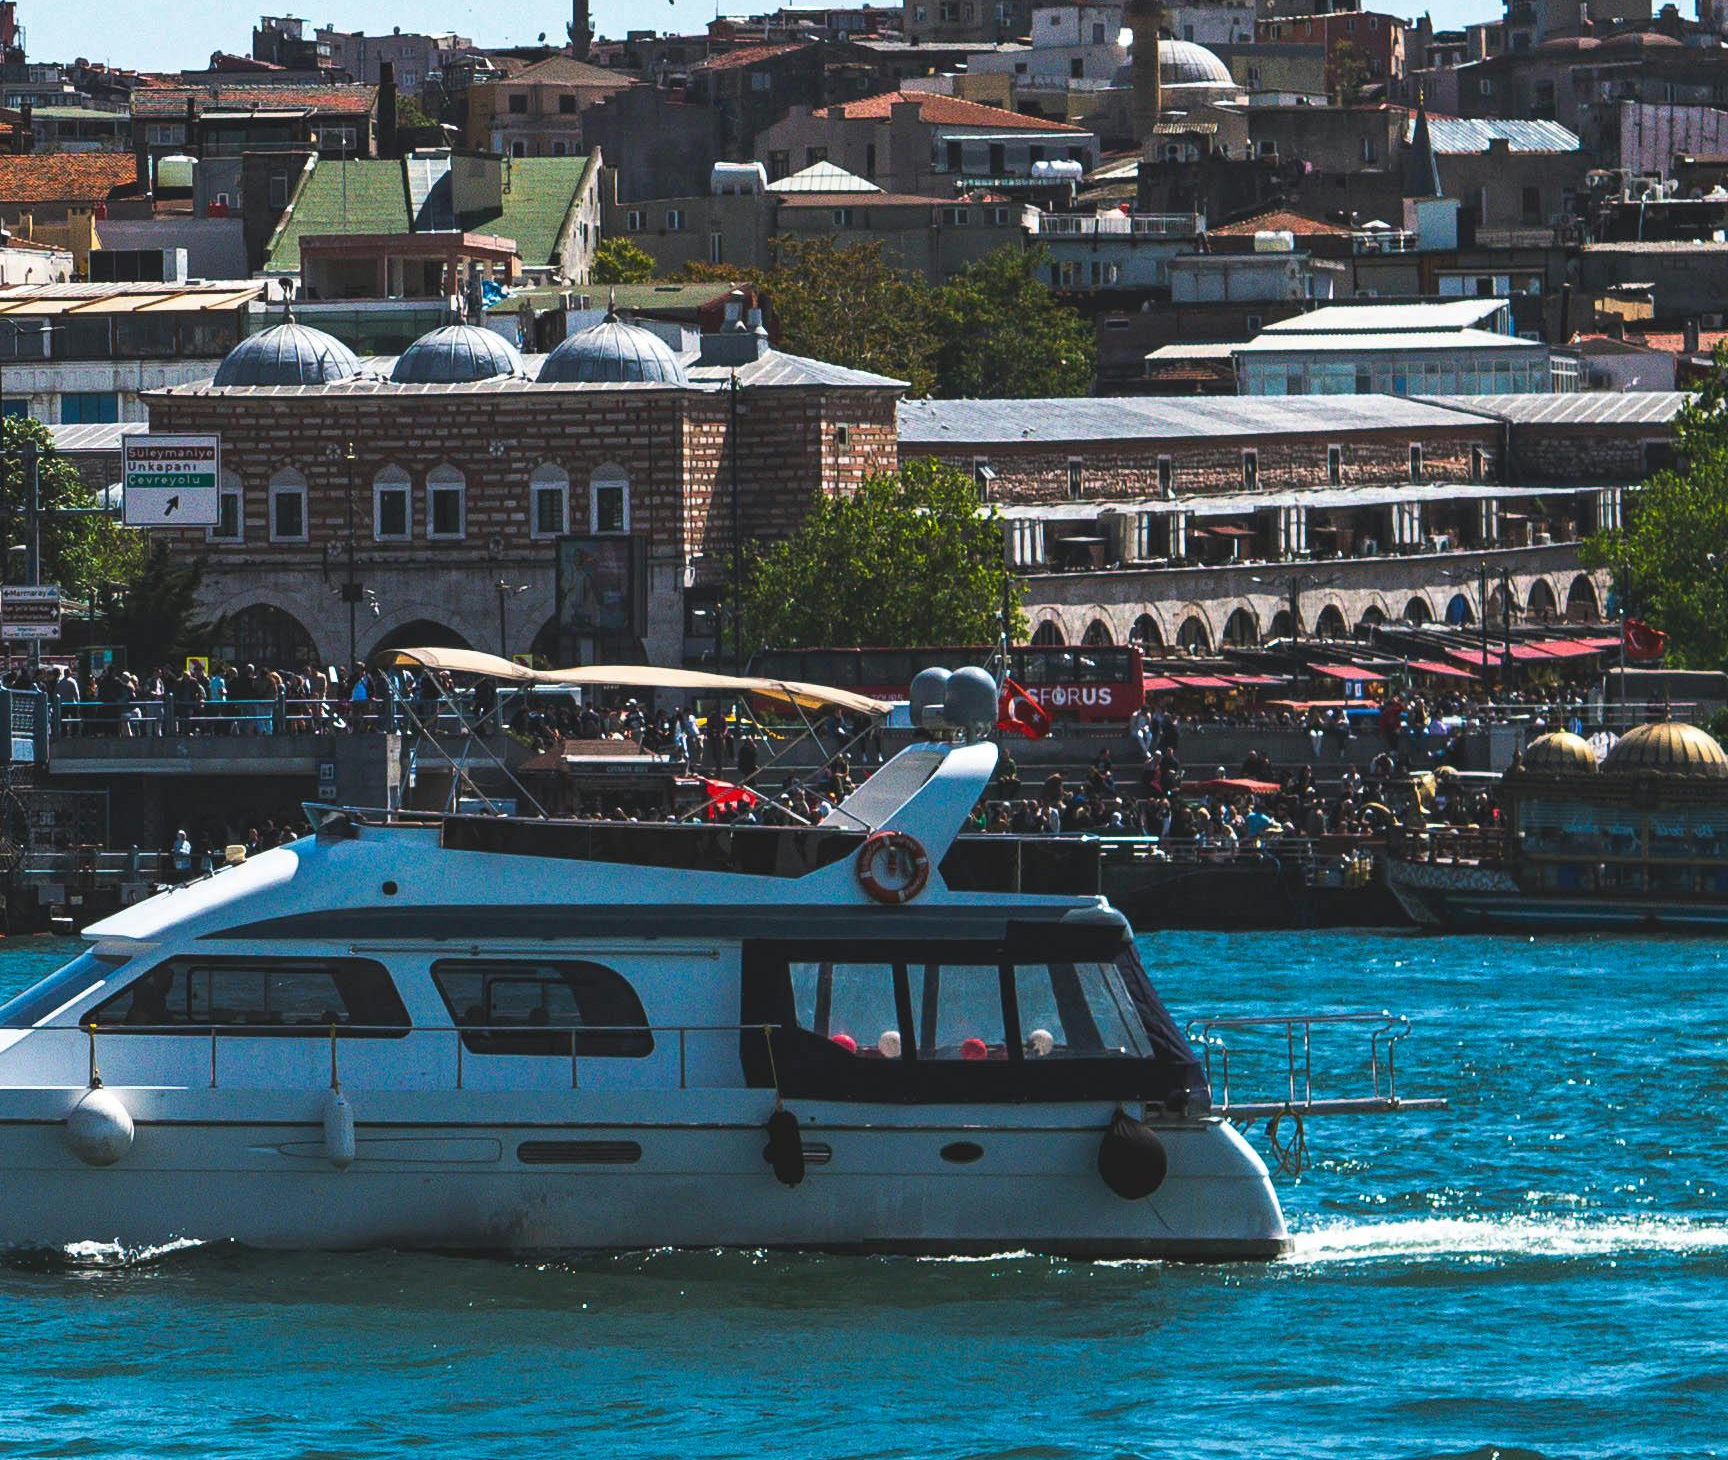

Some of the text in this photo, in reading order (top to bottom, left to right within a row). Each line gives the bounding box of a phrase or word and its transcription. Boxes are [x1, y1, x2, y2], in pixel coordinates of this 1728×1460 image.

[128, 447, 213, 459] Süleymaniye
[127, 461, 197, 472] Unkapanı
[128, 475, 200, 486] Çevreyolu
[10, 589, 47, 598] Marmaray
